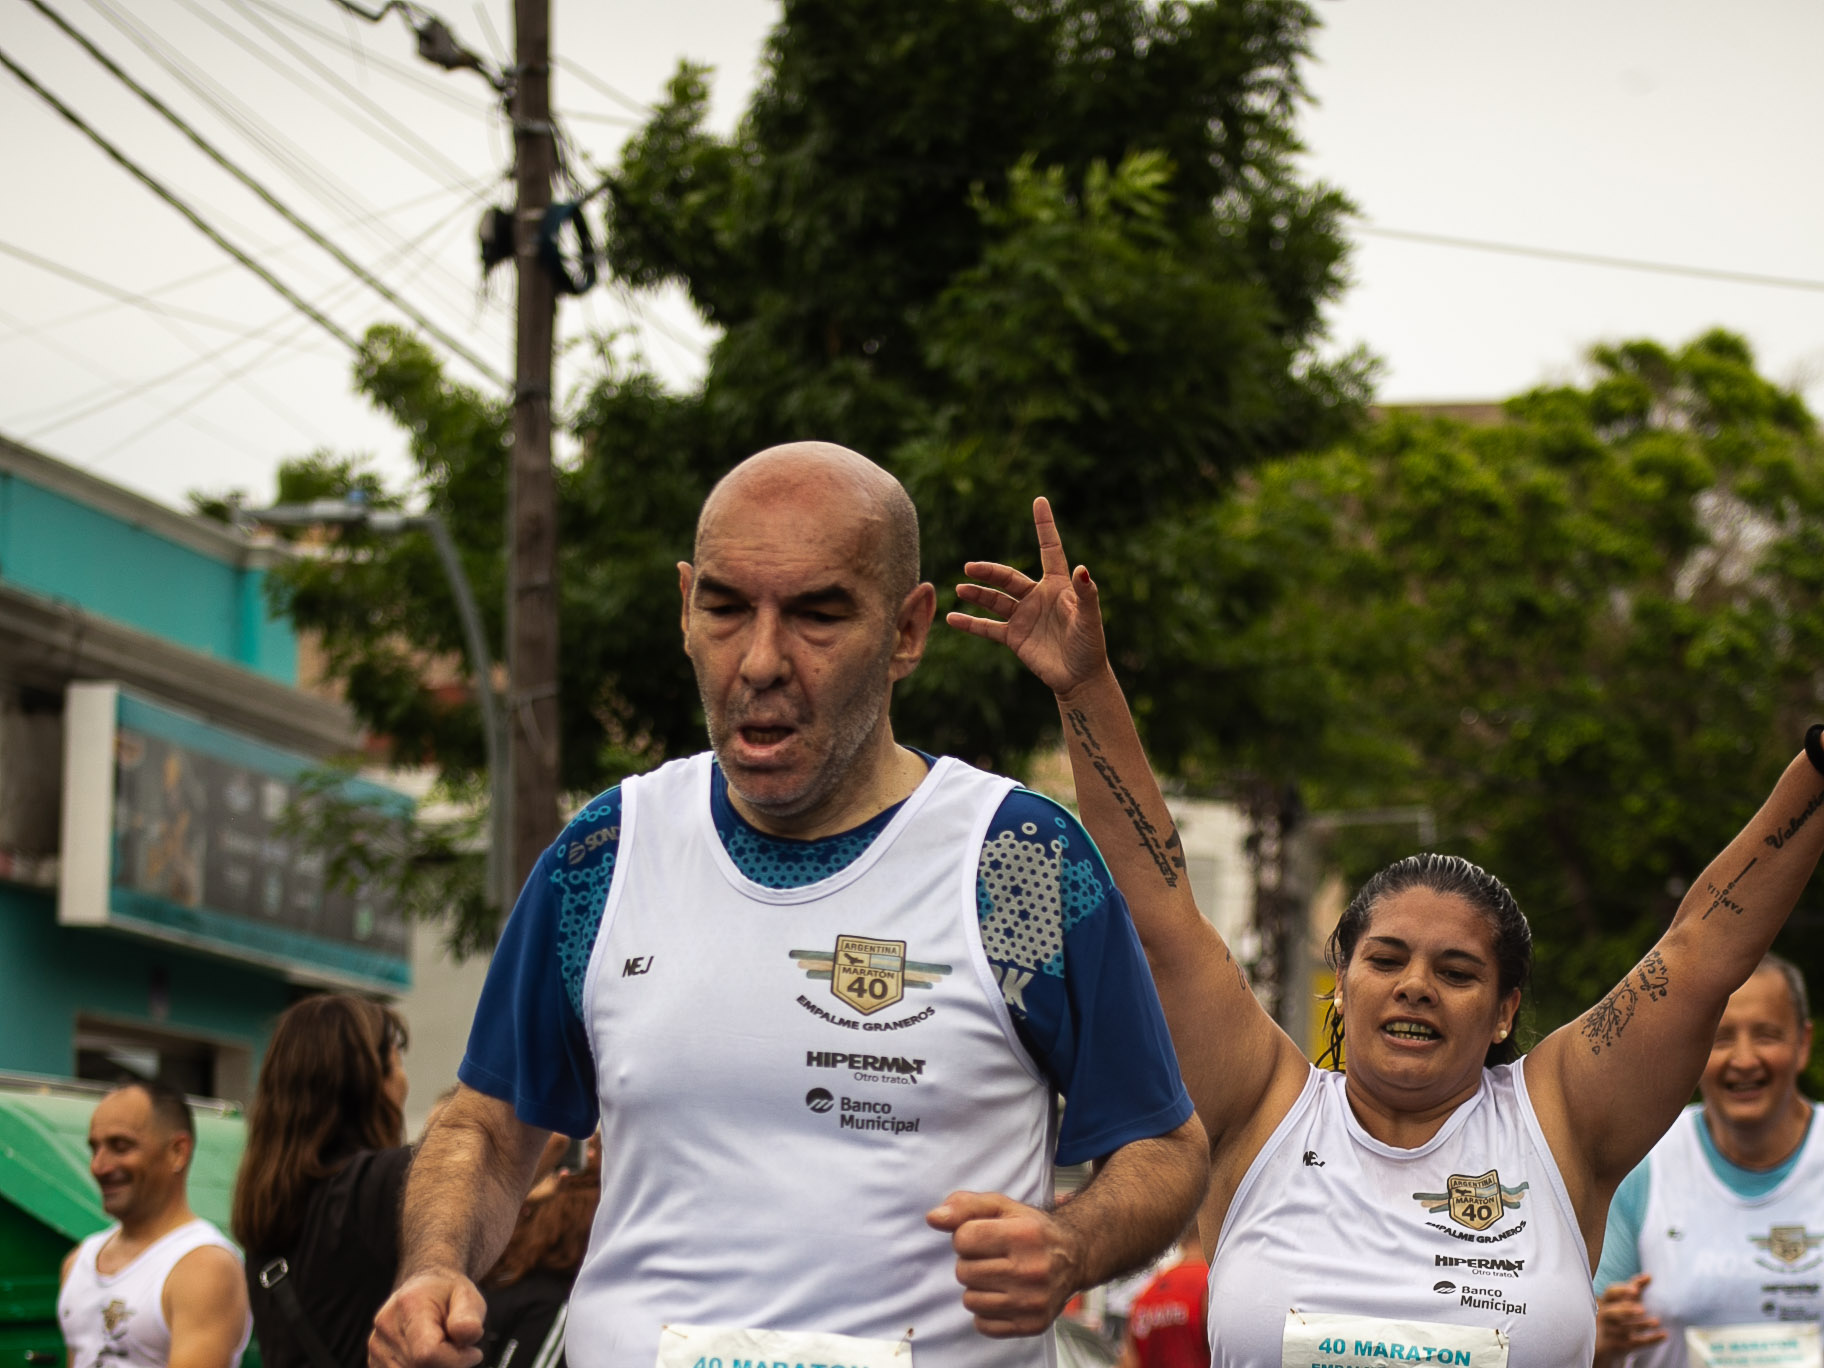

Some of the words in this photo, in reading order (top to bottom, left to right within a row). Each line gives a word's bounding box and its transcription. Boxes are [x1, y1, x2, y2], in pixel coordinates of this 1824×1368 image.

[844, 943, 897, 954] ARGENTINA
[622, 956, 653, 977] NEJ
[847, 976, 888, 1000] 40
[796, 994, 860, 1030] EMPALME
[862, 1006, 936, 1031] GRANEROS
[854, 1072, 879, 1083] Otro
[881, 1074, 911, 1085] trato.
[841, 1096, 892, 1114] Banco
[840, 1114, 920, 1135] Municipal
[1453, 1178, 1493, 1187] ARGENTINA
[1461, 1204, 1493, 1221] 40
[1476, 1220, 1527, 1243] GRANEROS
[1461, 1286, 1503, 1298] Banco
[1460, 1295, 1527, 1315] Municipal
[1318, 1338, 1346, 1355] 40
[1354, 1340, 1471, 1367] MARATON
